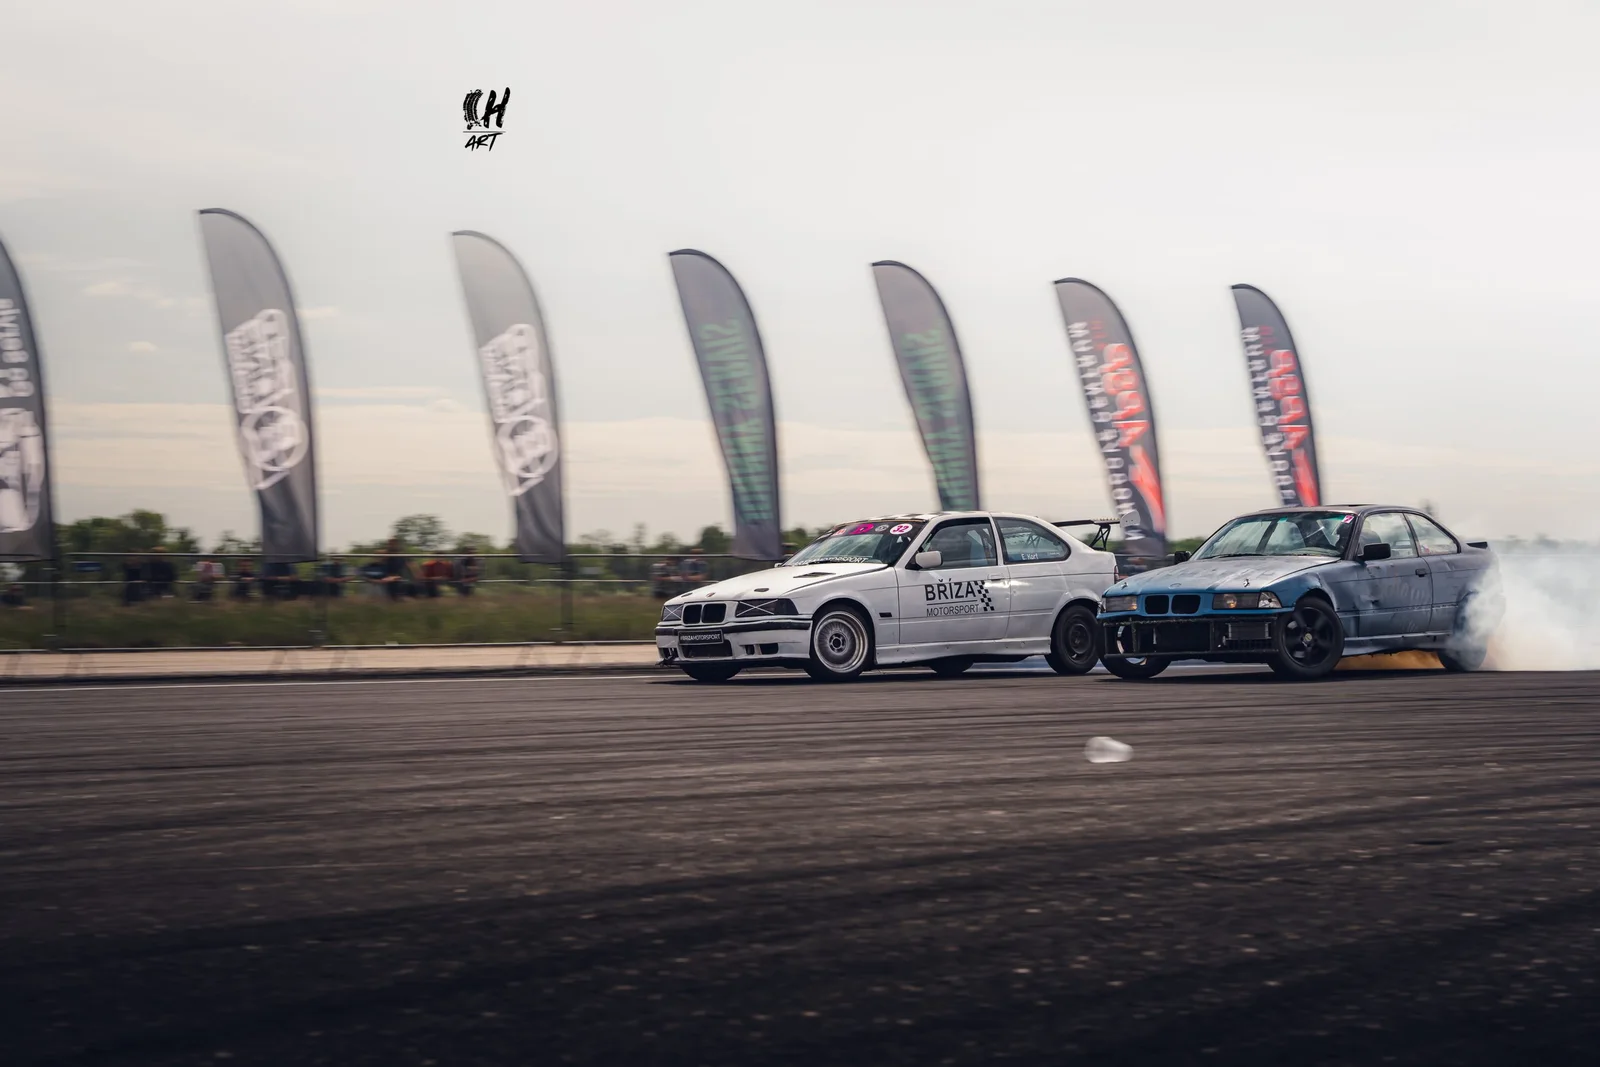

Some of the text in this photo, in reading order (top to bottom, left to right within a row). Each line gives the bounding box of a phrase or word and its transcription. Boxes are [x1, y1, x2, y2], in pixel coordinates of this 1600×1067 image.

[892, 523, 909, 533] 32
[924, 578, 976, 601] BŘÍZA
[926, 603, 979, 617] MOTORSPORT
